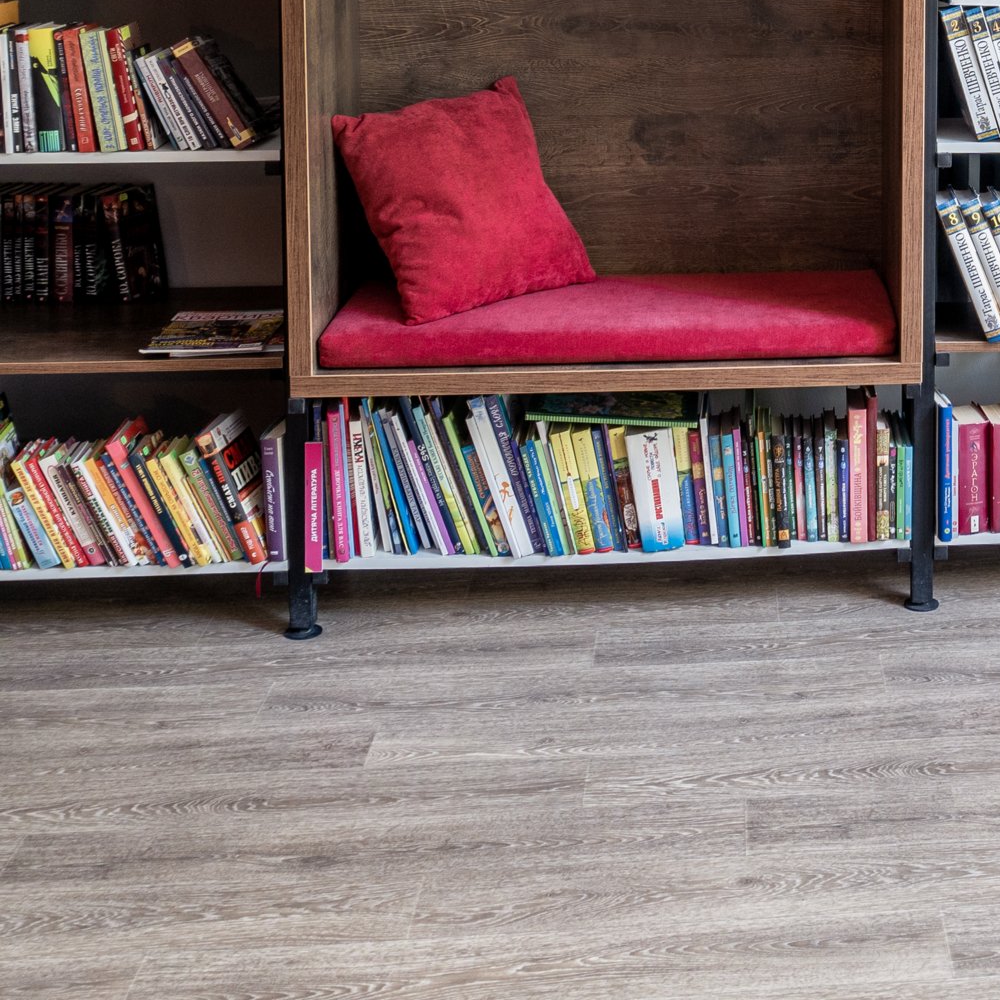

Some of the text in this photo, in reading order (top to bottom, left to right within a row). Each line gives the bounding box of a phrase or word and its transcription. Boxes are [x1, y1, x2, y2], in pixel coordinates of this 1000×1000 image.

[954, 39, 987, 118] Тарас ШЕВЧЕНКО
[955, 233, 993, 316] Тарас ШЕВЧЕНКО
[353, 433, 363, 463] КАЗКИ
[310, 469, 318, 510] ЛІТЕРАТУРА
[854, 473, 862, 520] БОЙКІВЩИНА
